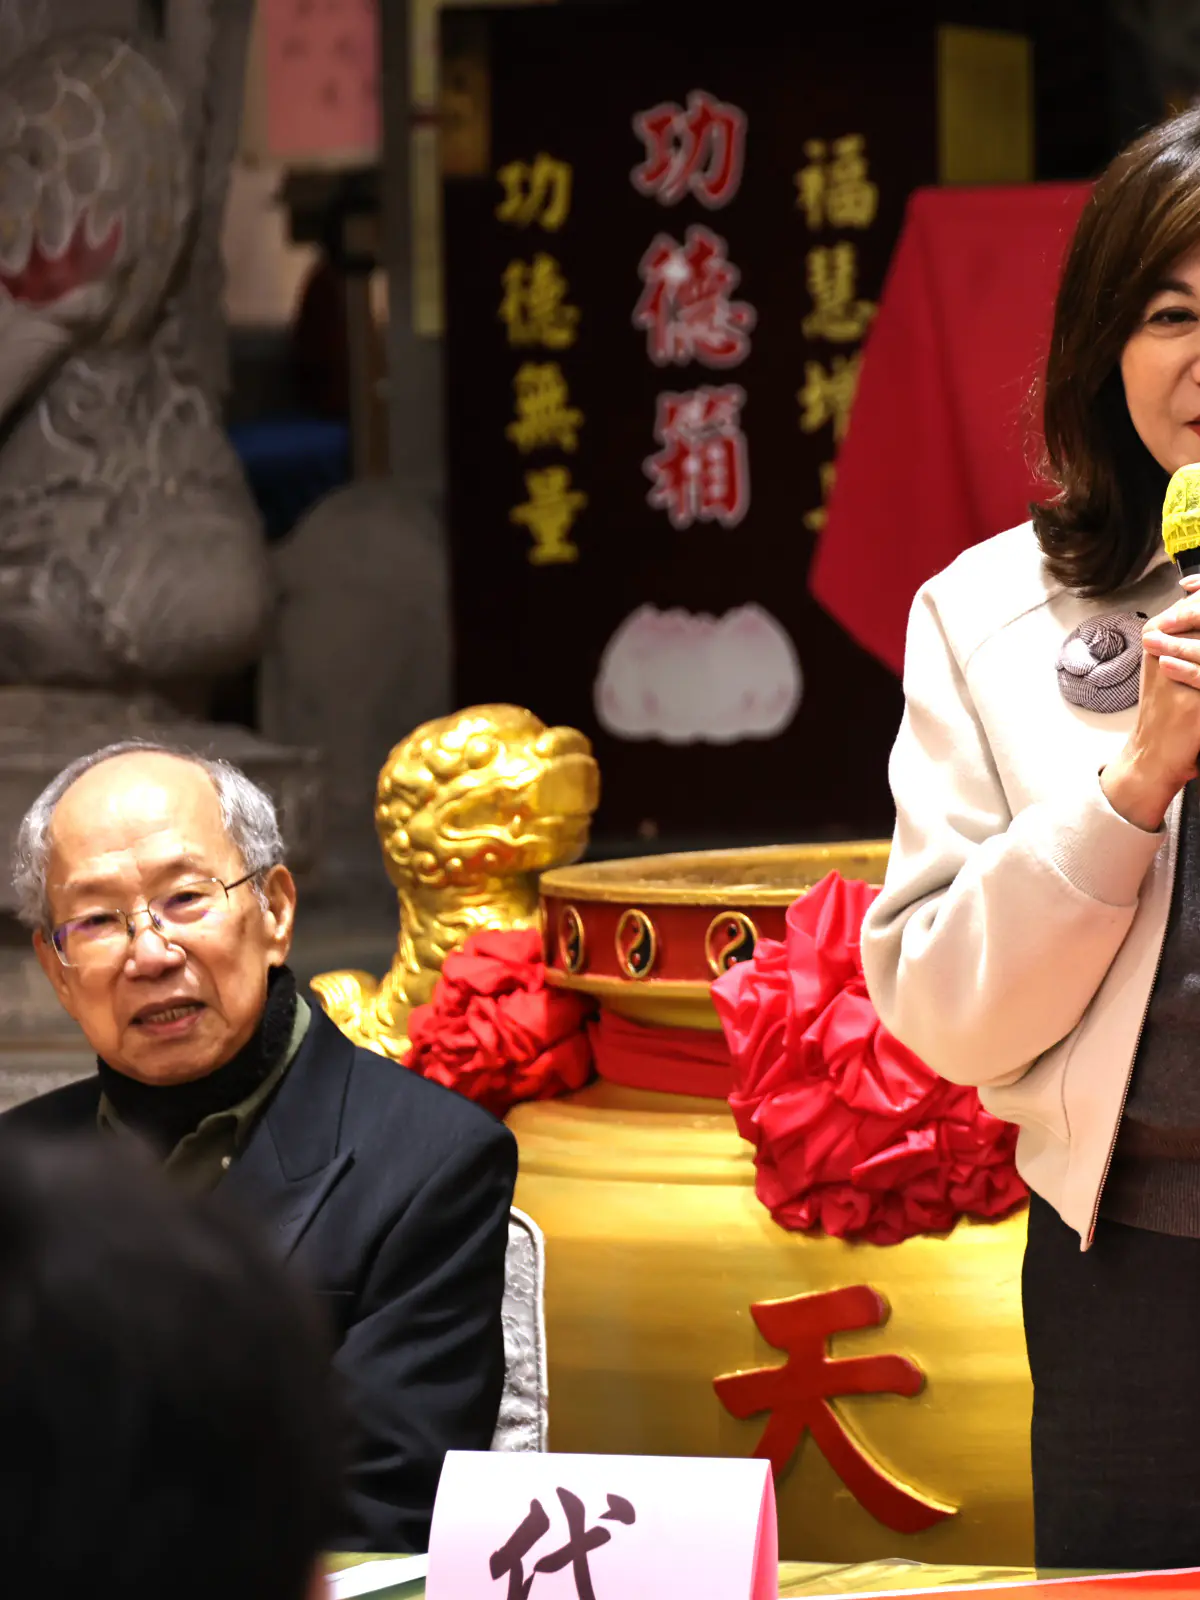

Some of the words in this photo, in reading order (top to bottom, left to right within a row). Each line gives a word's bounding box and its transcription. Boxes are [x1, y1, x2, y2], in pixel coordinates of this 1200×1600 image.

[497, 153, 586, 566] 功德無量
[631, 89, 756, 528] 功德箱
[713, 1284, 957, 1533] 天
